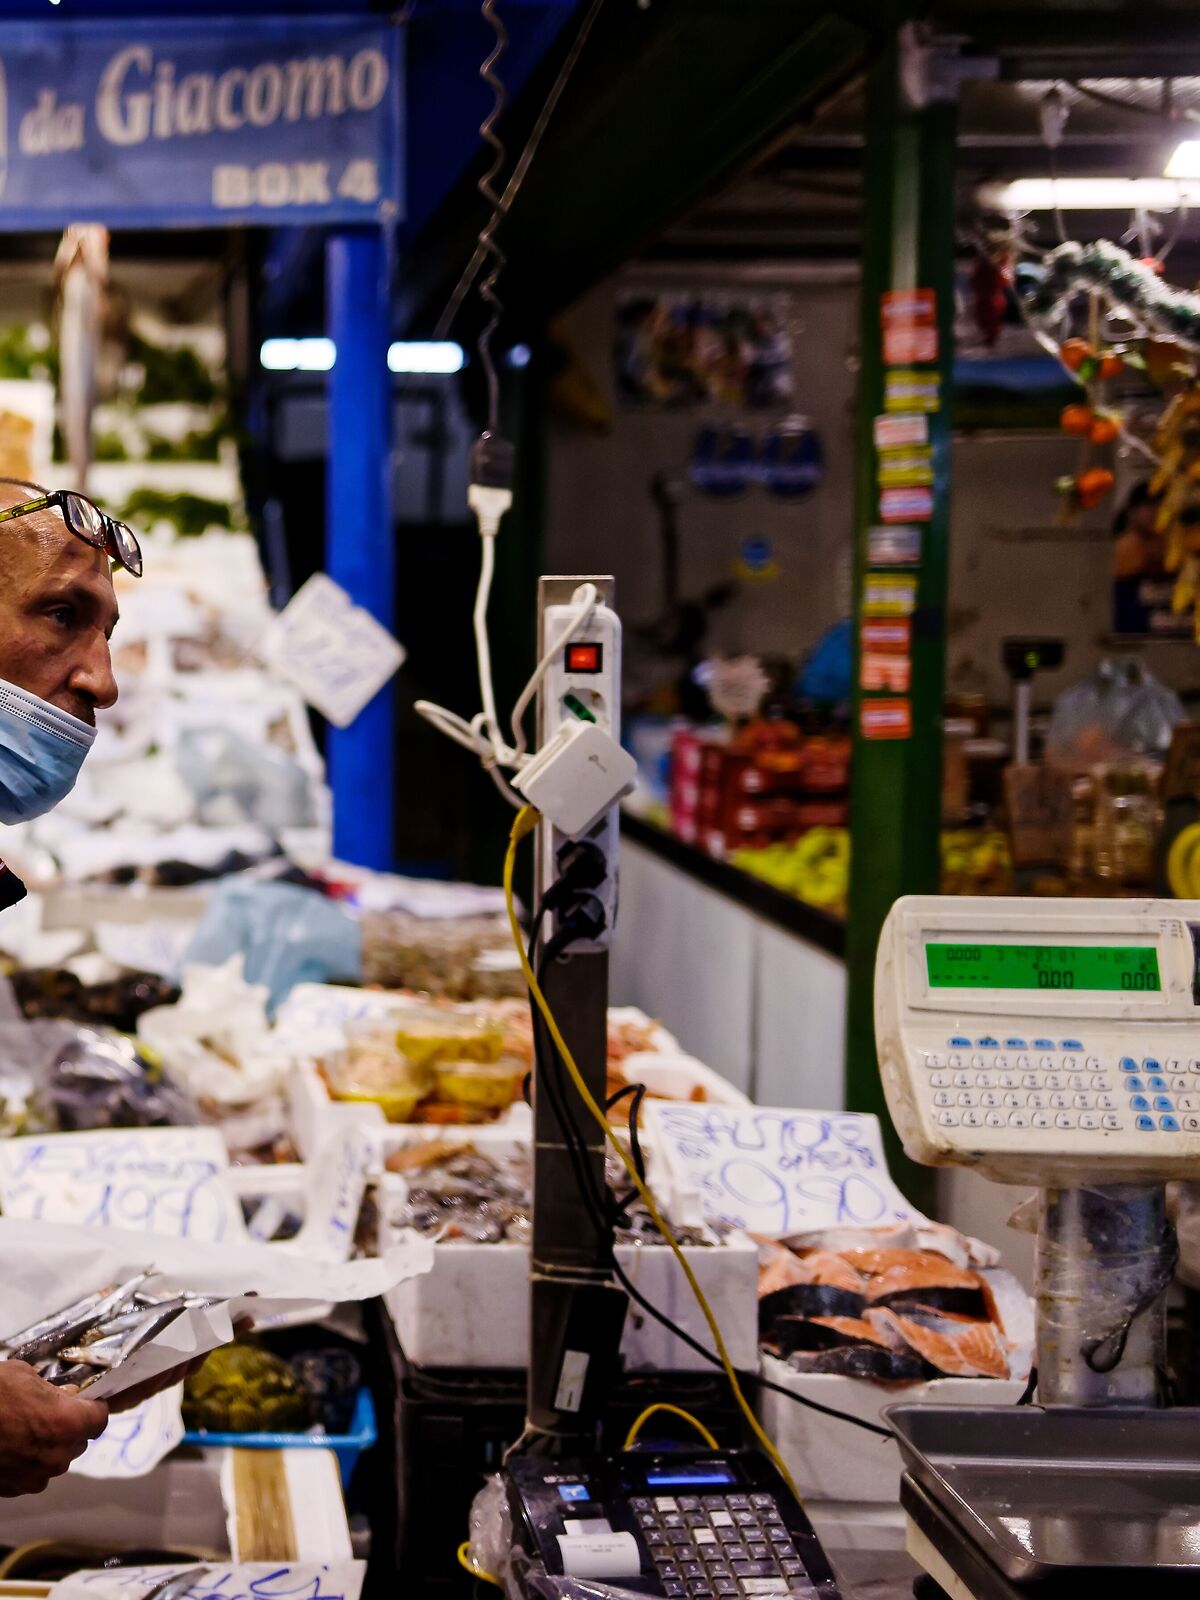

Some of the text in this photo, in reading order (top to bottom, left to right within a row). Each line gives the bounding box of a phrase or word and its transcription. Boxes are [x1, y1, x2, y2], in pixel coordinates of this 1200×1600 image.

[19, 89, 85, 156] da
[96, 45, 388, 146] Giacomo
[212, 158, 379, 208] BOX 4
